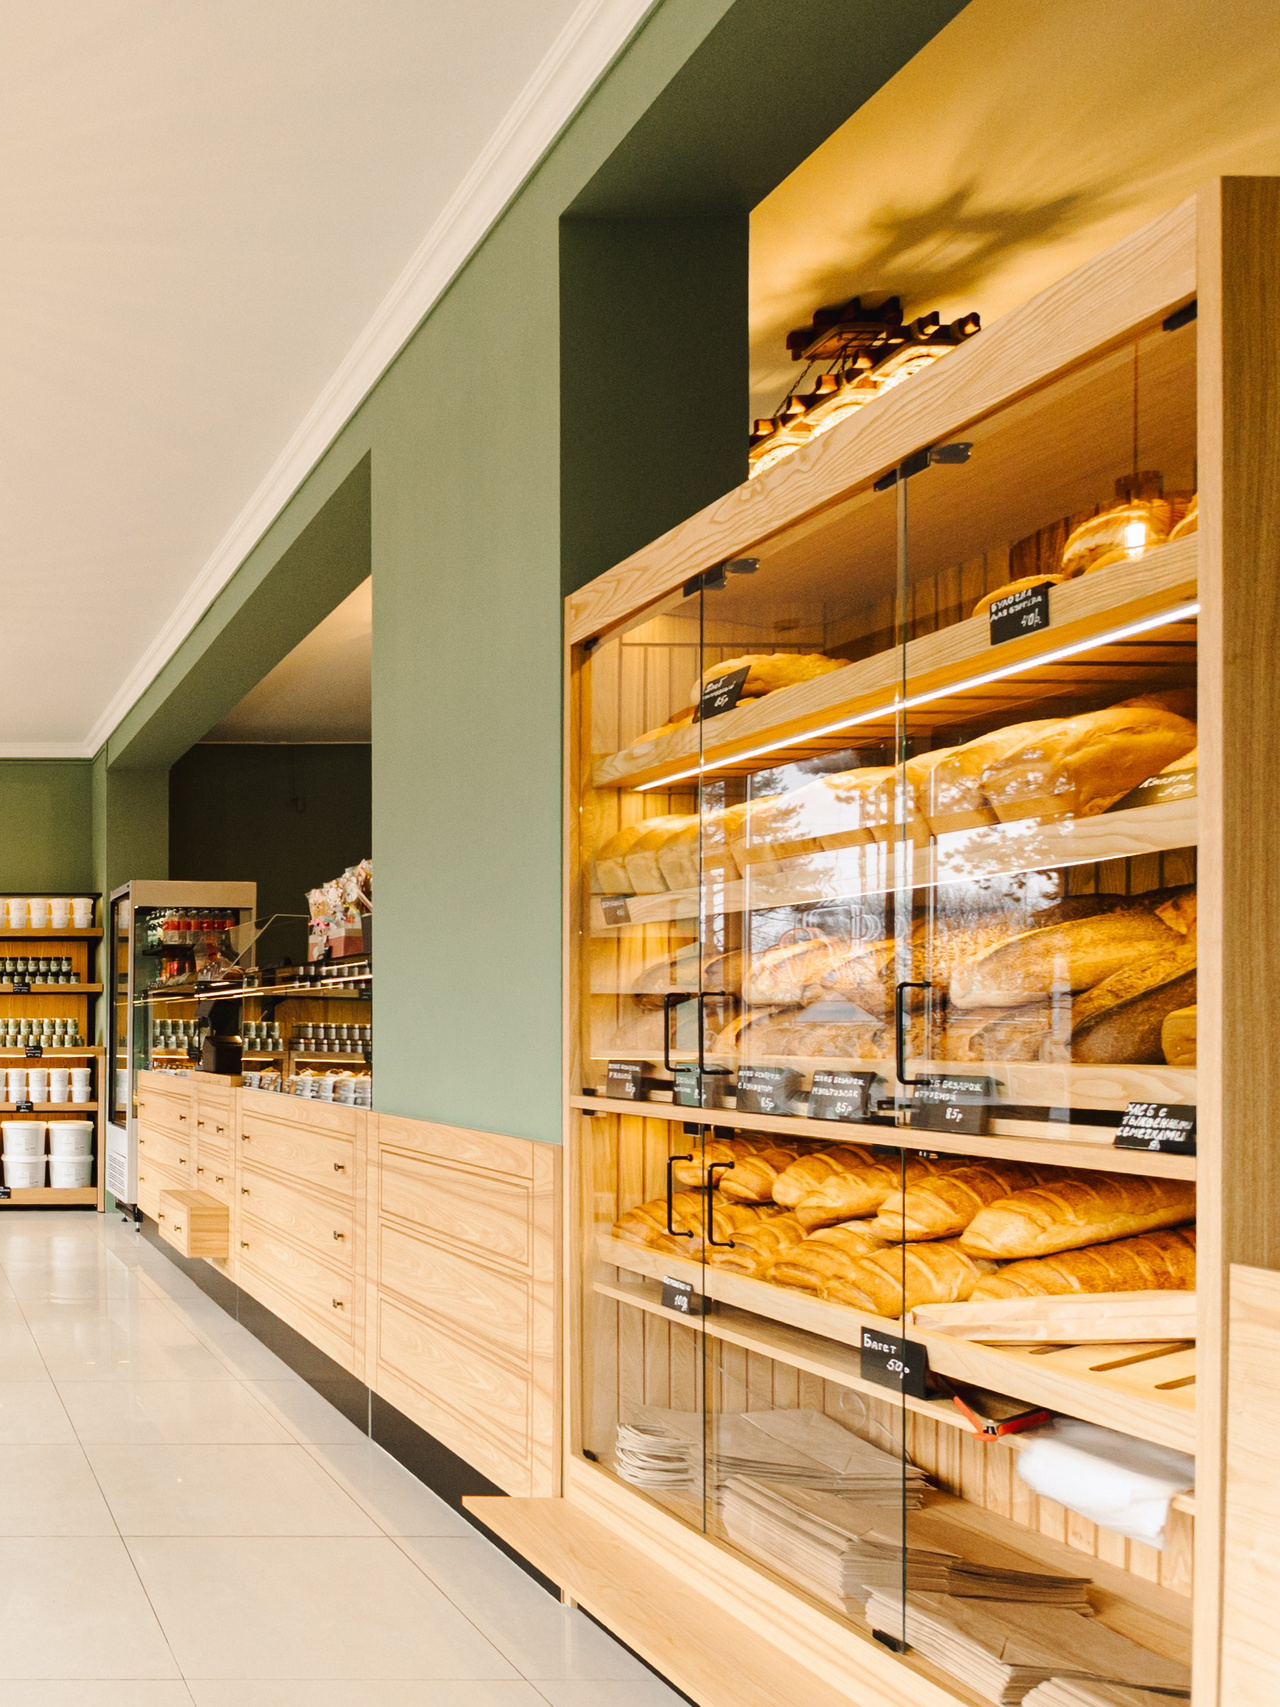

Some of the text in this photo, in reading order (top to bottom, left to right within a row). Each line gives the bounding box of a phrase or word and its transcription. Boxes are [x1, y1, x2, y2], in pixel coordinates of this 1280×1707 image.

[945, 1107, 963, 1123] 85р
[1125, 1103, 1157, 1117] ХЛЕБ
[886, 1358, 910, 1379] 50р
